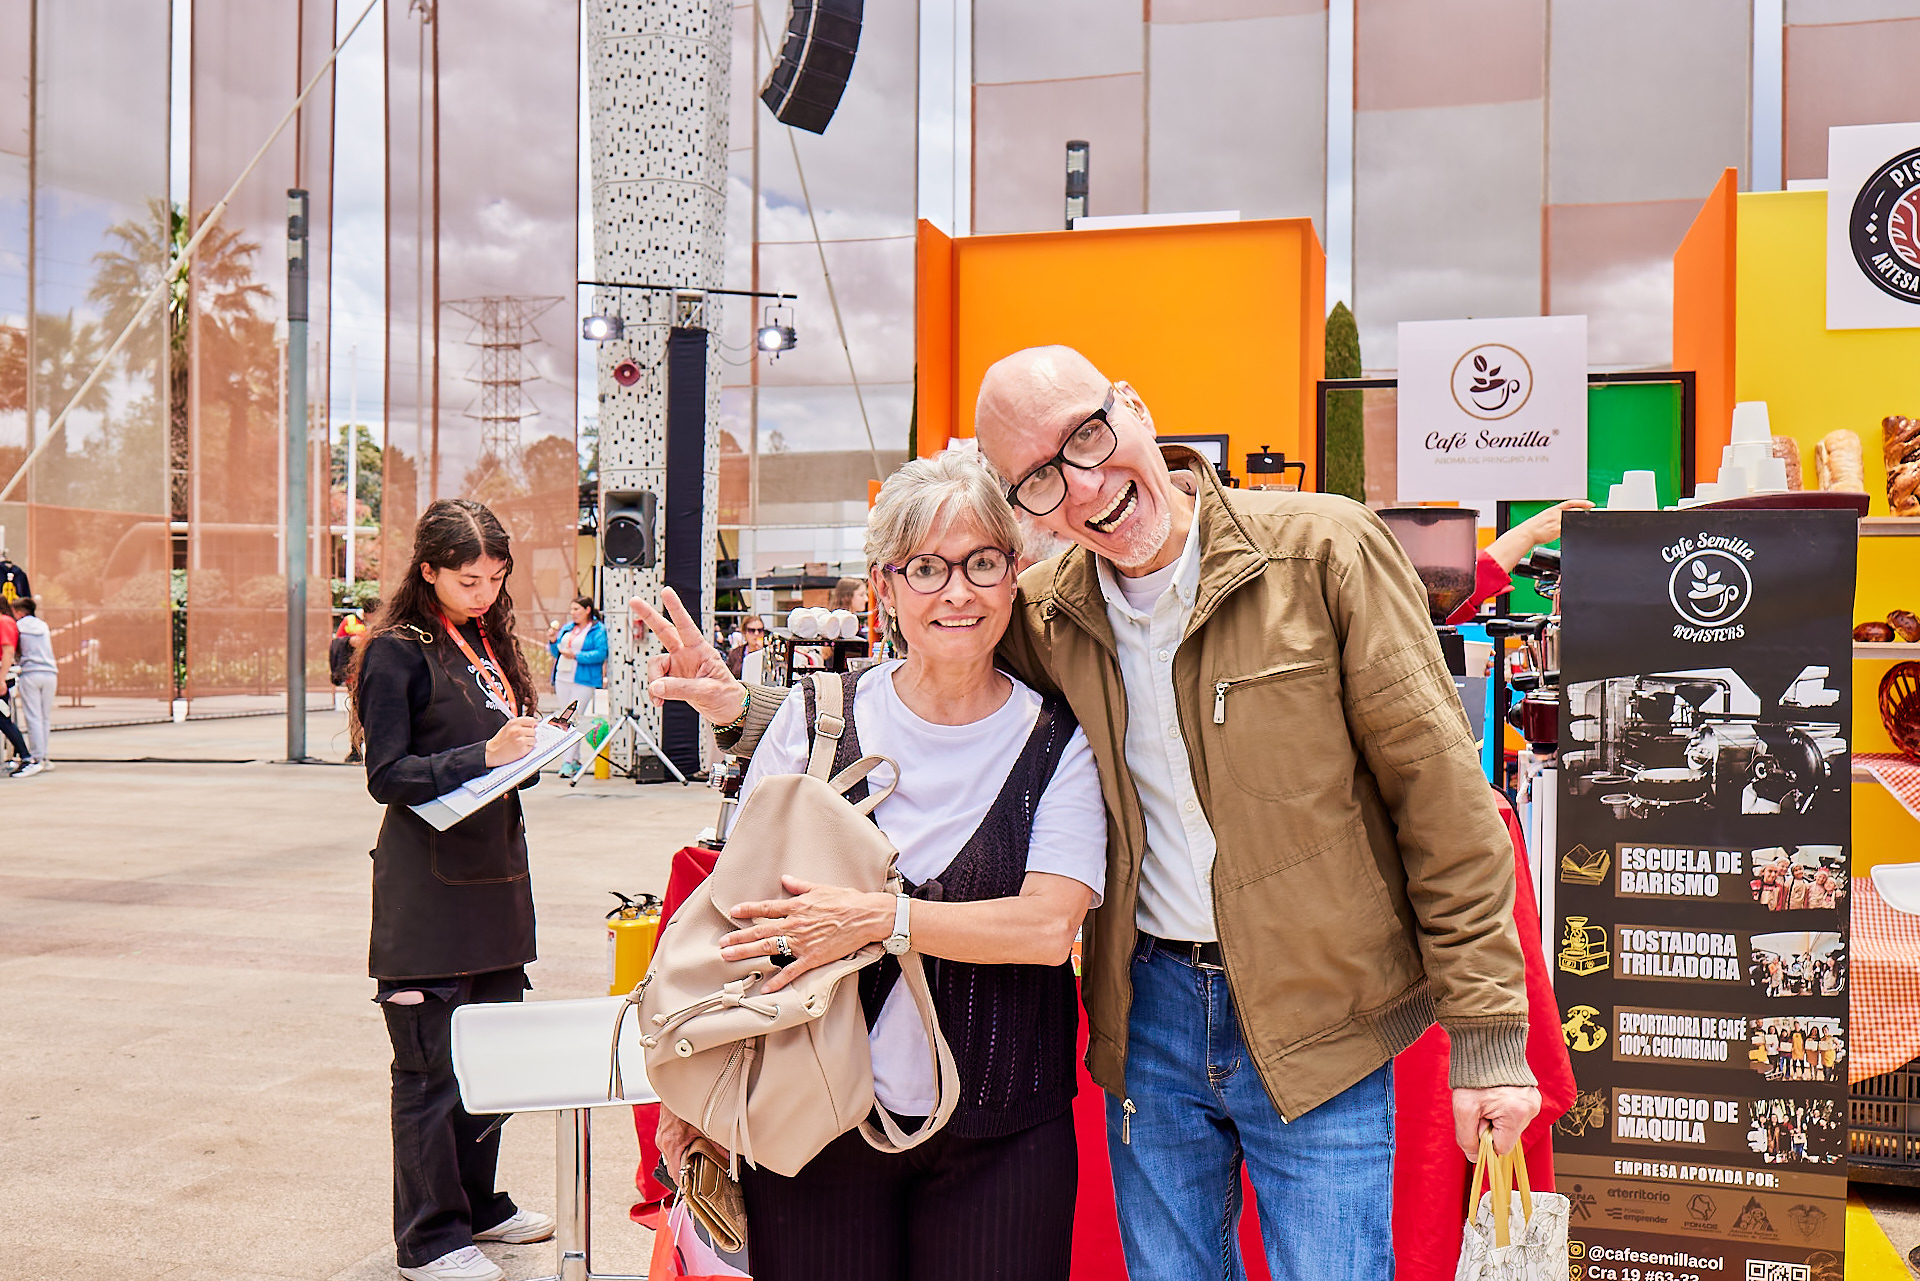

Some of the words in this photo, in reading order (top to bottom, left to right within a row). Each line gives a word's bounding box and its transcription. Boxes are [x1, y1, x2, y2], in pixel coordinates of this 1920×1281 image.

[1425, 431, 1467, 453] Café
[1434, 456, 1466, 464] AROMA
[1468, 456, 1480, 464] DE
[1535, 455, 1550, 463] FIN
[1661, 536, 1694, 563] Cafe
[1697, 531, 1756, 561] Semilla
[1672, 623, 1745, 643] ROASTERS
[1621, 847, 1711, 874] ESCUELA
[1715, 851, 1742, 875] DE
[1620, 871, 1720, 897] BARISMO
[1620, 929, 1737, 957] TOSTADORA
[1620, 953, 1741, 981] TRILLADORA
[1619, 1012, 1700, 1038] EXPORTADORA
[1701, 1017, 1717, 1038] DE
[1718, 1016, 1747, 1041] CAFÉ
[1619, 1034, 1651, 1056] 100%
[1652, 1036, 1728, 1062] COLOMBIANO
[1617, 1093, 1709, 1121] SERVICIO
[1713, 1100, 1739, 1124] DE
[1617, 1116, 1706, 1144] MAQUILA
[1614, 1160, 1678, 1179] EMPRESA
[1679, 1166, 1743, 1185] APOYADA
[1746, 1171, 1780, 1188] POR:
[1623, 1214, 1668, 1224] emprender
[1588, 1245, 1724, 1271] @cafesemillacol
[1588, 1265, 1617, 1281] Cra
[1621, 1268, 1641, 1281] 19
